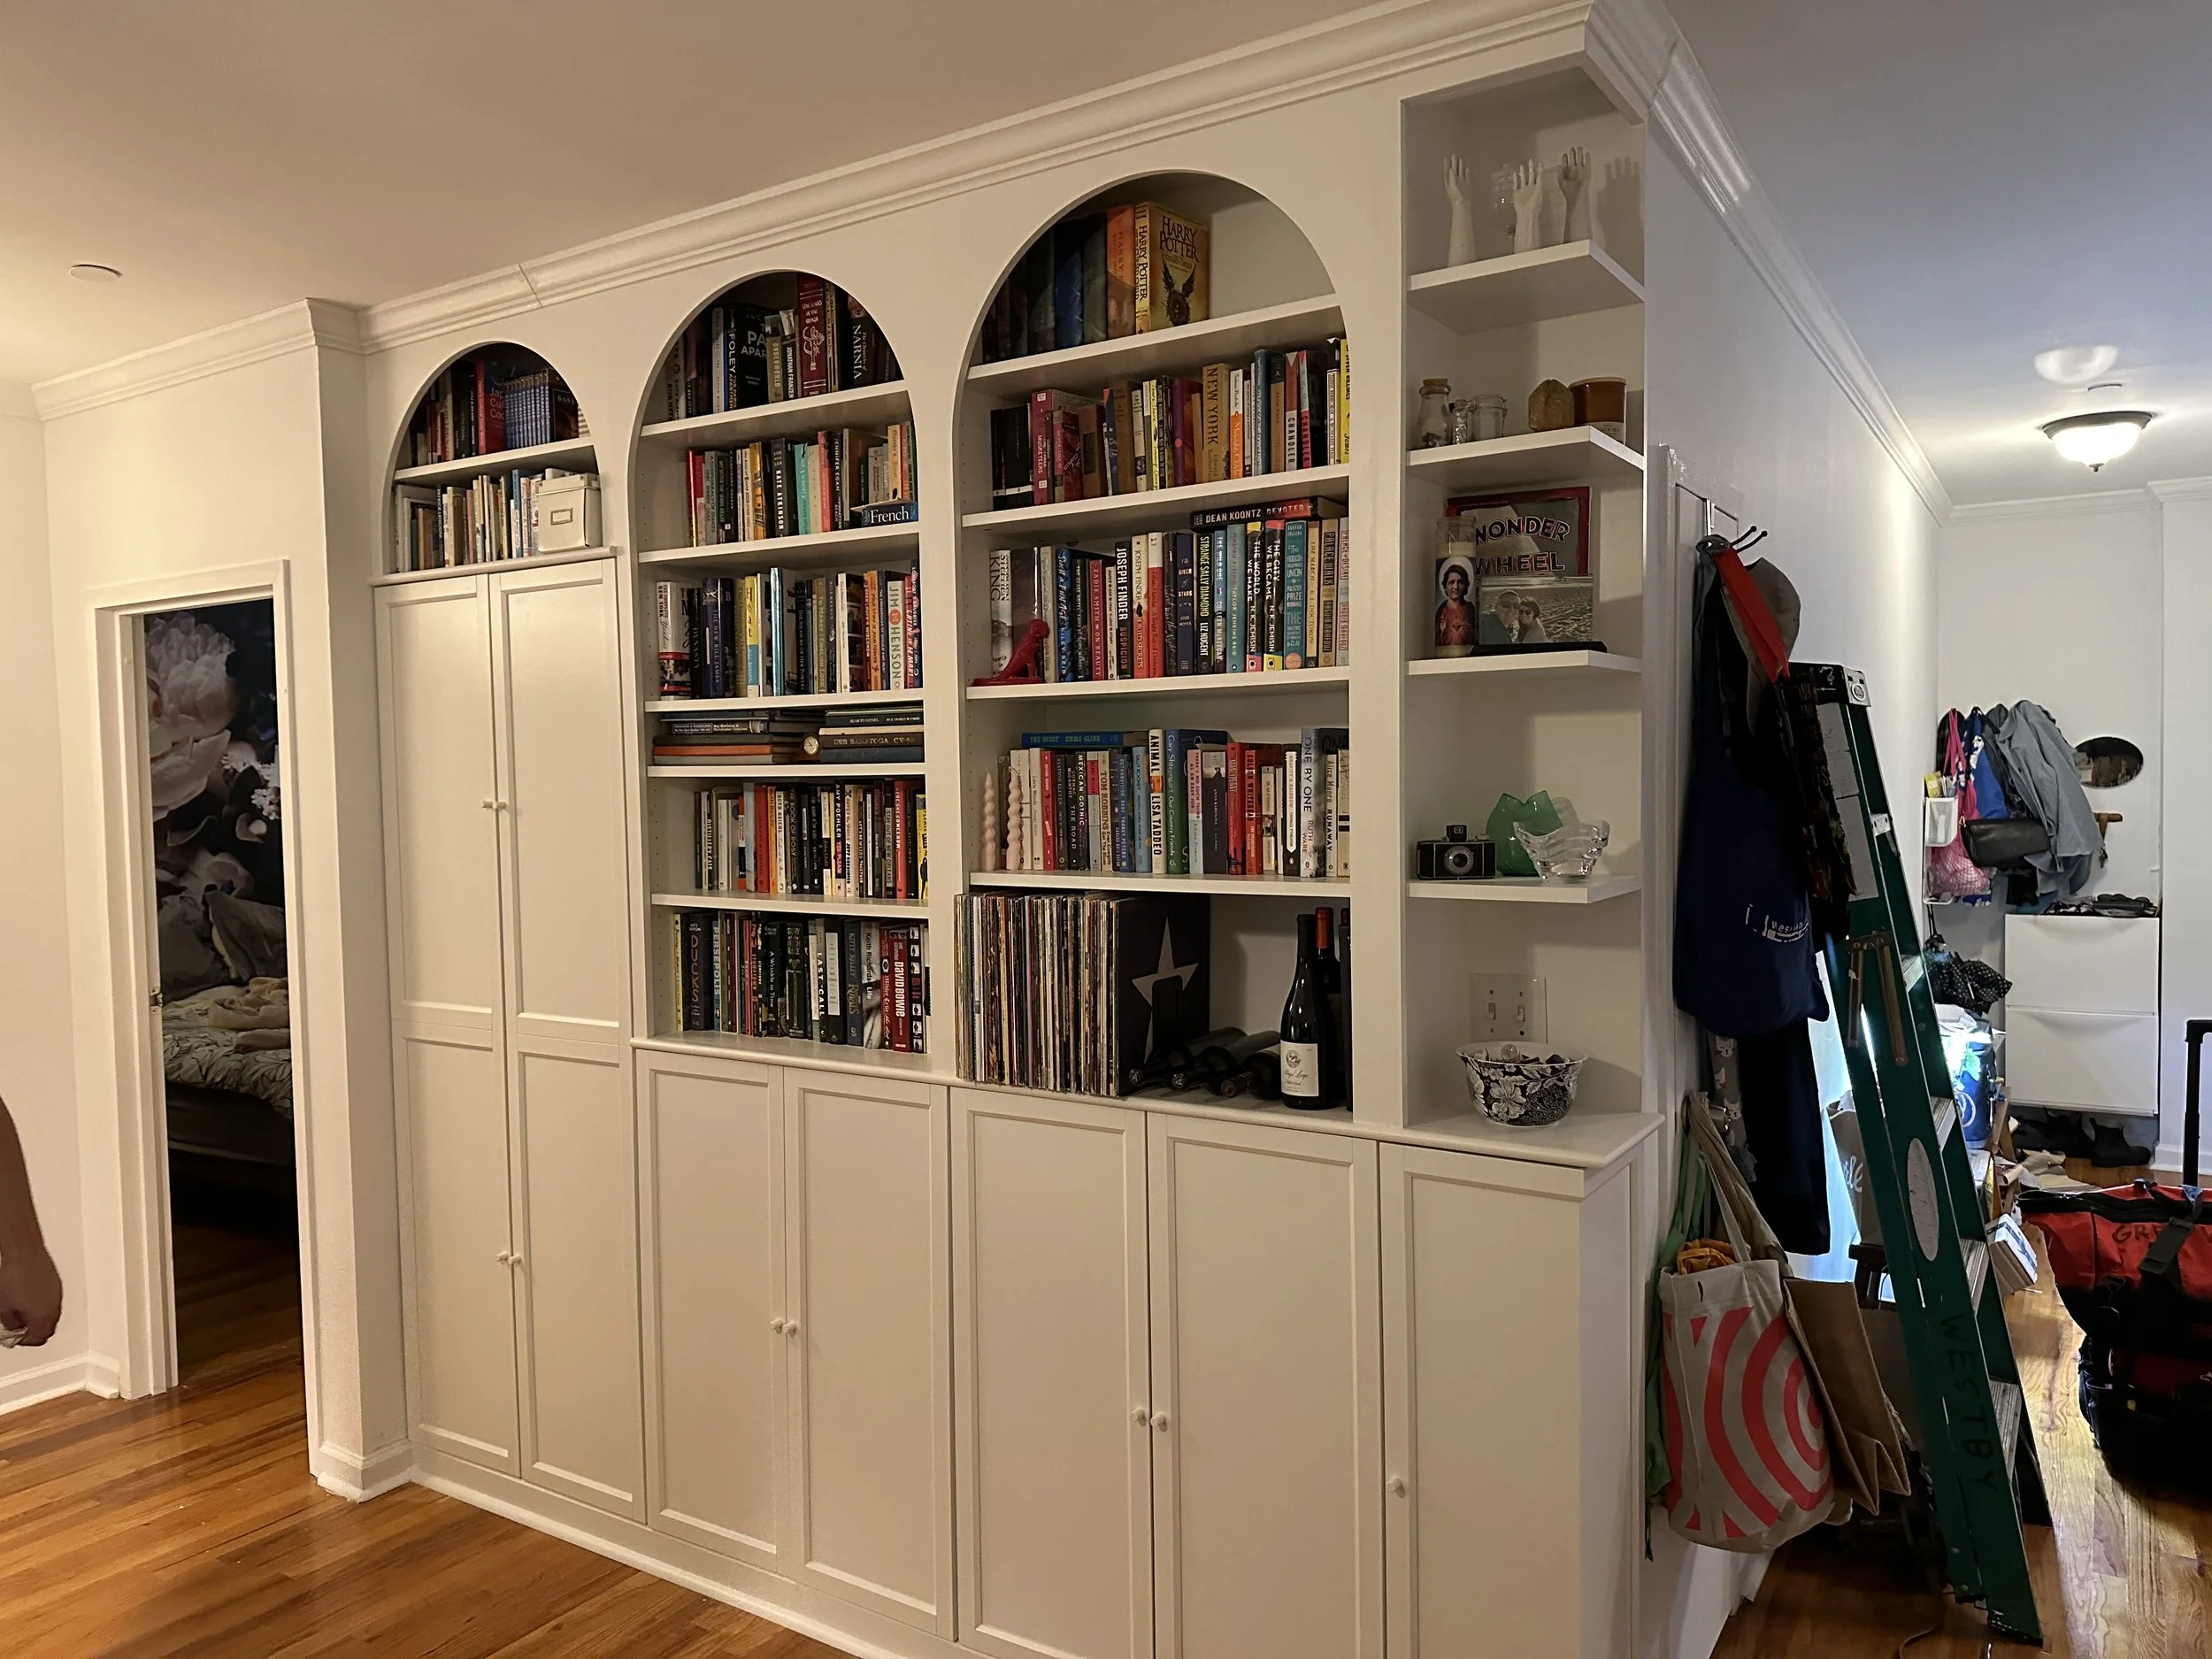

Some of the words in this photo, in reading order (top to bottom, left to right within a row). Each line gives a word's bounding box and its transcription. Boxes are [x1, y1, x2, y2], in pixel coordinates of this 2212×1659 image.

[1162, 215, 1197, 244] HARRY
[1139, 226, 1148, 262] HARRY
[1159, 231, 1200, 263] POTTER
[1140, 263, 1148, 302] POTTER
[852, 324, 863, 380] NARNIA
[1206, 367, 1218, 403] NEW
[1207, 405, 1219, 445] YORK
[1287, 417, 1296, 464] CHANDLER
[1302, 415, 1310, 463] CHANDLER
[870, 507, 910, 525] French
[1205, 513, 1227, 524] DEAN
[1229, 508, 1262, 520] KOONTZ
[1266, 503, 1304, 515] DEVOTED
[1200, 536, 1209, 565] STRANGE
[1267, 546, 1272, 563] WE
[1324, 532, 1334, 562] PALACE
[1116, 547, 1127, 584] JOSEPH
[1200, 565, 1210, 585] SALLY
[1247, 559, 1253, 575] WE
[1287, 568, 1302, 577] UNION
[1324, 563, 1334, 585] WALK
[1475, 552, 1566, 575] WHEEL
[990, 556, 1001, 602] KING
[1000, 554, 1010, 602] STEPHEN
[888, 588, 899, 609] JIM
[1118, 586, 1129, 621] FINDER
[1200, 586, 1210, 617] DIAMOND
[1286, 592, 1302, 601] PRIZE
[1200, 622, 1209, 632] LIZ
[1286, 612, 1302, 625] THE
[1094, 632, 1101, 642] ON
[1200, 633, 1209, 657] NUGENT
[891, 626, 902, 680] HENSON
[1150, 735, 1160, 773] ANIMAL
[1166, 734, 1175, 753] Gary
[1303, 737, 1313, 764] ONE
[1303, 768, 1313, 781] BY
[1326, 760, 1335, 778] Alice
[1303, 786, 1313, 812] ONE
[1326, 780, 1335, 803] Munro
[1152, 795, 1161, 816] LISA
[1152, 818, 1162, 856] TADDEO
[848, 933, 856, 952] KITTY
[690, 933, 701, 1002] DUCKS
[849, 954, 857, 978] KELLEY
[1939, 1313, 1997, 1492] WESTBY
